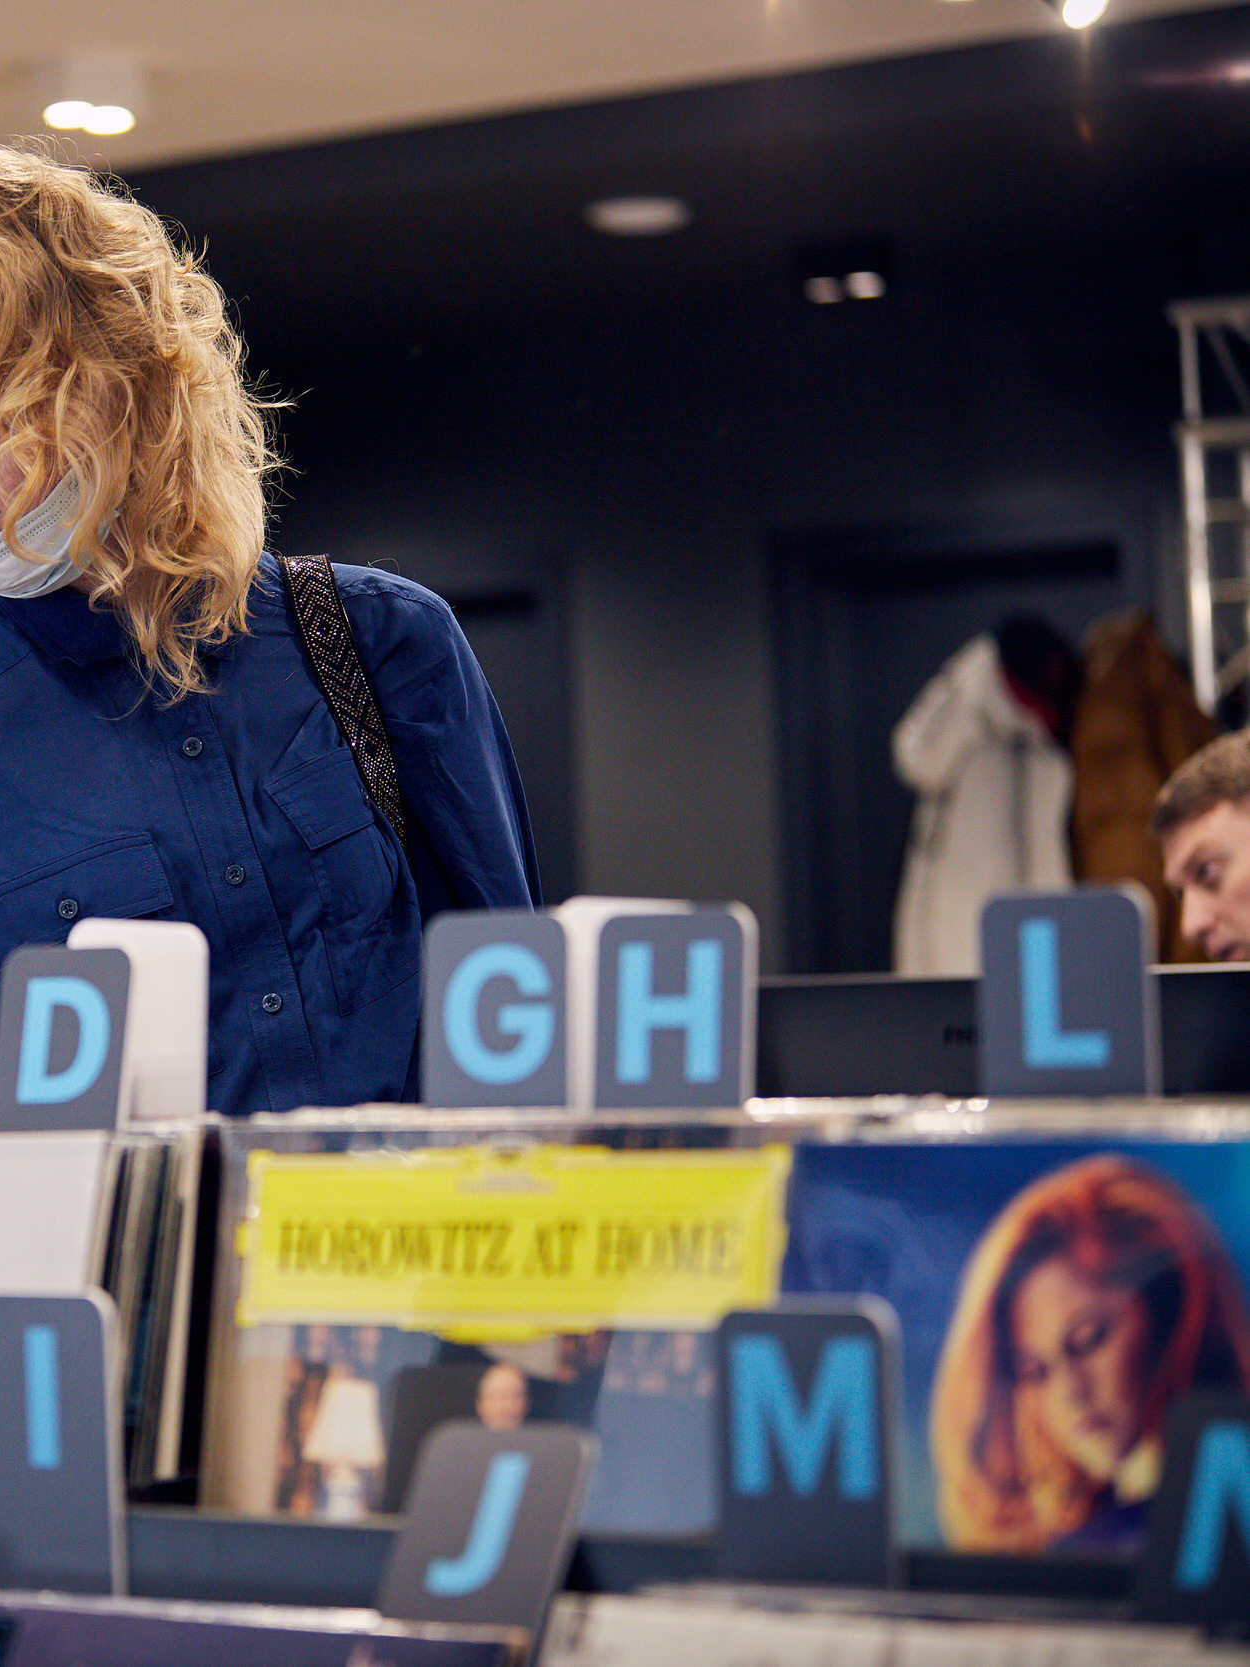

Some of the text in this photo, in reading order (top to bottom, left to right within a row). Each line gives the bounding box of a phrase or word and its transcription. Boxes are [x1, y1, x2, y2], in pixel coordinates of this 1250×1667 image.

[15, 975, 112, 1105] D
[442, 942, 556, 1086] G
[615, 940, 725, 1084] H
[1019, 918, 1111, 1069] L
[279, 1216, 745, 1280] HOROWITZ AT HOME
[23, 1326, 63, 1470] I
[728, 1333, 879, 1499] M
[423, 1451, 531, 1598] J
